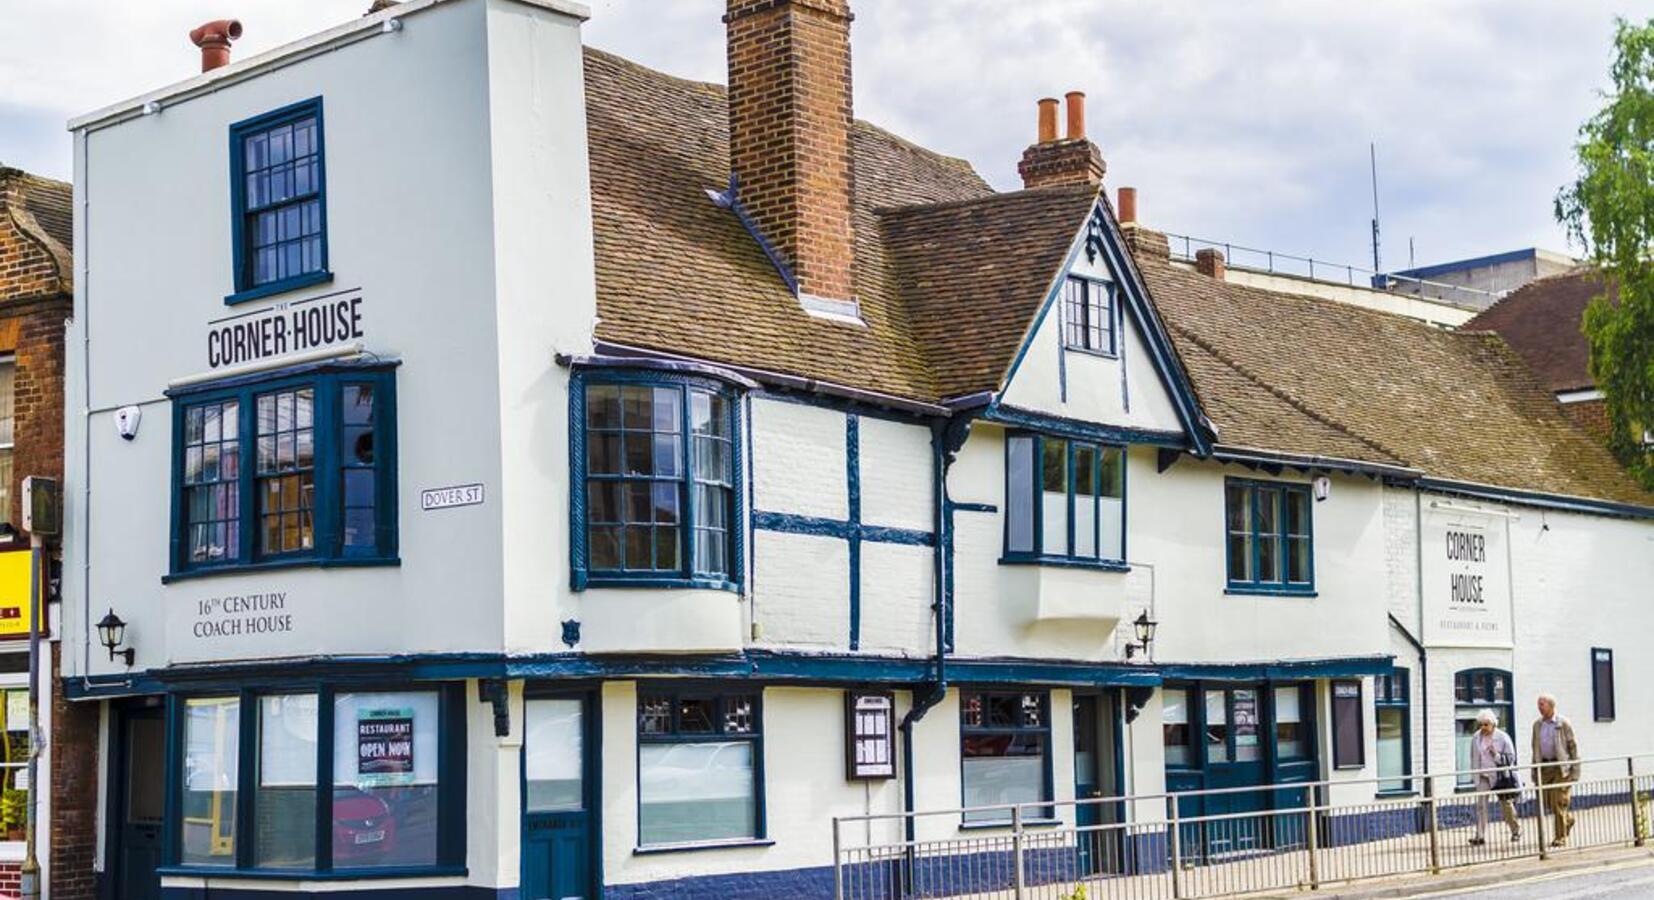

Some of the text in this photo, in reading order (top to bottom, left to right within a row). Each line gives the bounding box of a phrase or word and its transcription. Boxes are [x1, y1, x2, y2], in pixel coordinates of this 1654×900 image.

[425, 487, 479, 507] DOVER ST
[1446, 531, 1486, 562] CORNER
[1451, 573, 1484, 604] HOUSE
[223, 592, 287, 613] CENTURY
[193, 614, 293, 637] COACH HOUSE
[360, 724, 410, 735] RESTAURANT
[360, 741, 411, 757] OPEN NOW
